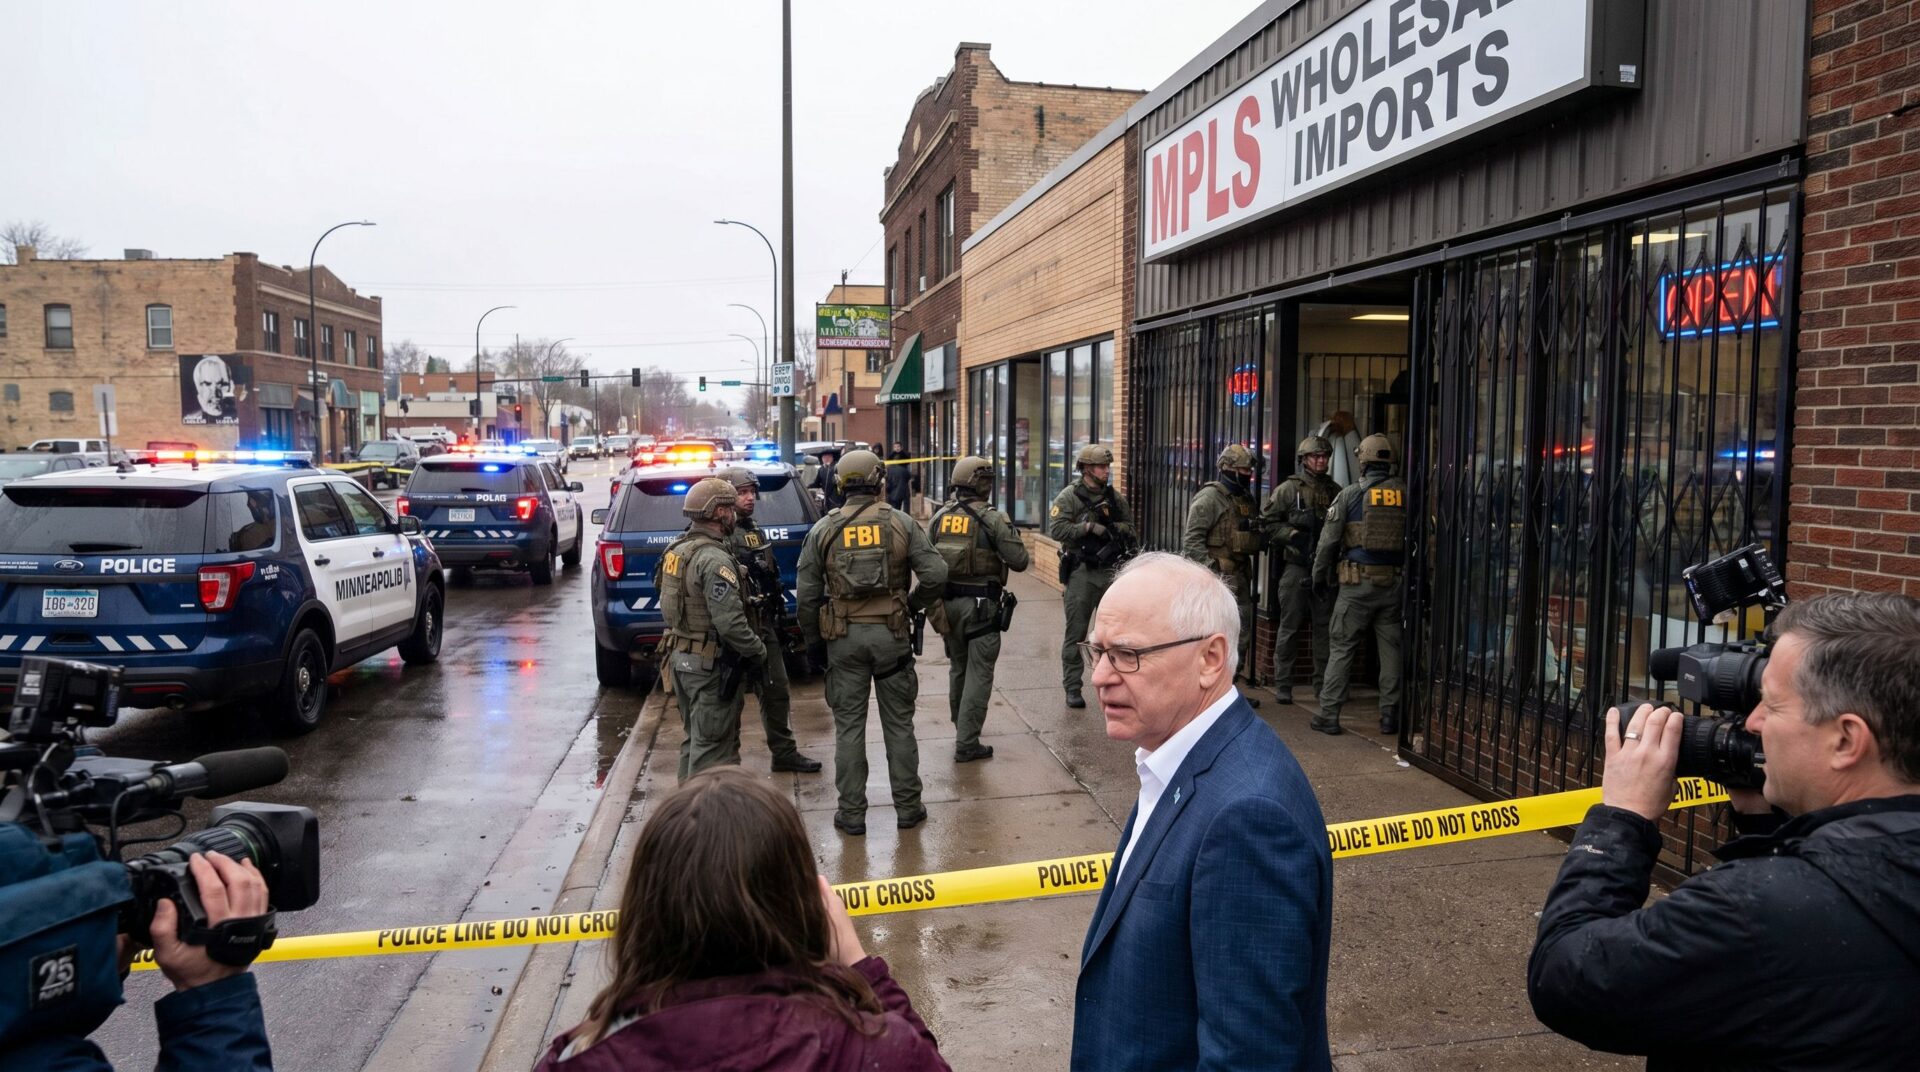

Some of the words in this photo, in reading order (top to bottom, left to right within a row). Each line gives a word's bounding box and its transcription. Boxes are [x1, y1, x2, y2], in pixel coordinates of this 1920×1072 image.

[1271, 0, 1514, 129] WHOLES
[1293, 29, 1509, 186] IMPORTS
[1151, 95, 1261, 245] MPLS
[1666, 267, 1776, 326] OPEN
[1370, 488, 1402, 506] FBI
[765, 528, 789, 540] ICE
[843, 525, 881, 547] FBI
[941, 515, 969, 534] FBI
[100, 558, 176, 574] POLICE
[1328, 825, 1371, 853] OLICE
[1374, 820, 1409, 846] LINE
[1412, 817, 1434, 841] DO
[1437, 813, 1466, 837] NOT
[1471, 805, 1520, 832] CROSS
[1037, 860, 1099, 889] POLICE
[836, 885, 870, 910] NOT
[876, 878, 935, 906] CROSS
[378, 925, 447, 948] POLICE
[453, 921, 496, 943] LINE
[503, 918, 529, 939] DO
[535, 914, 574, 937] NOT
[579, 911, 618, 934] CRO
[39, 955, 75, 991] 25
